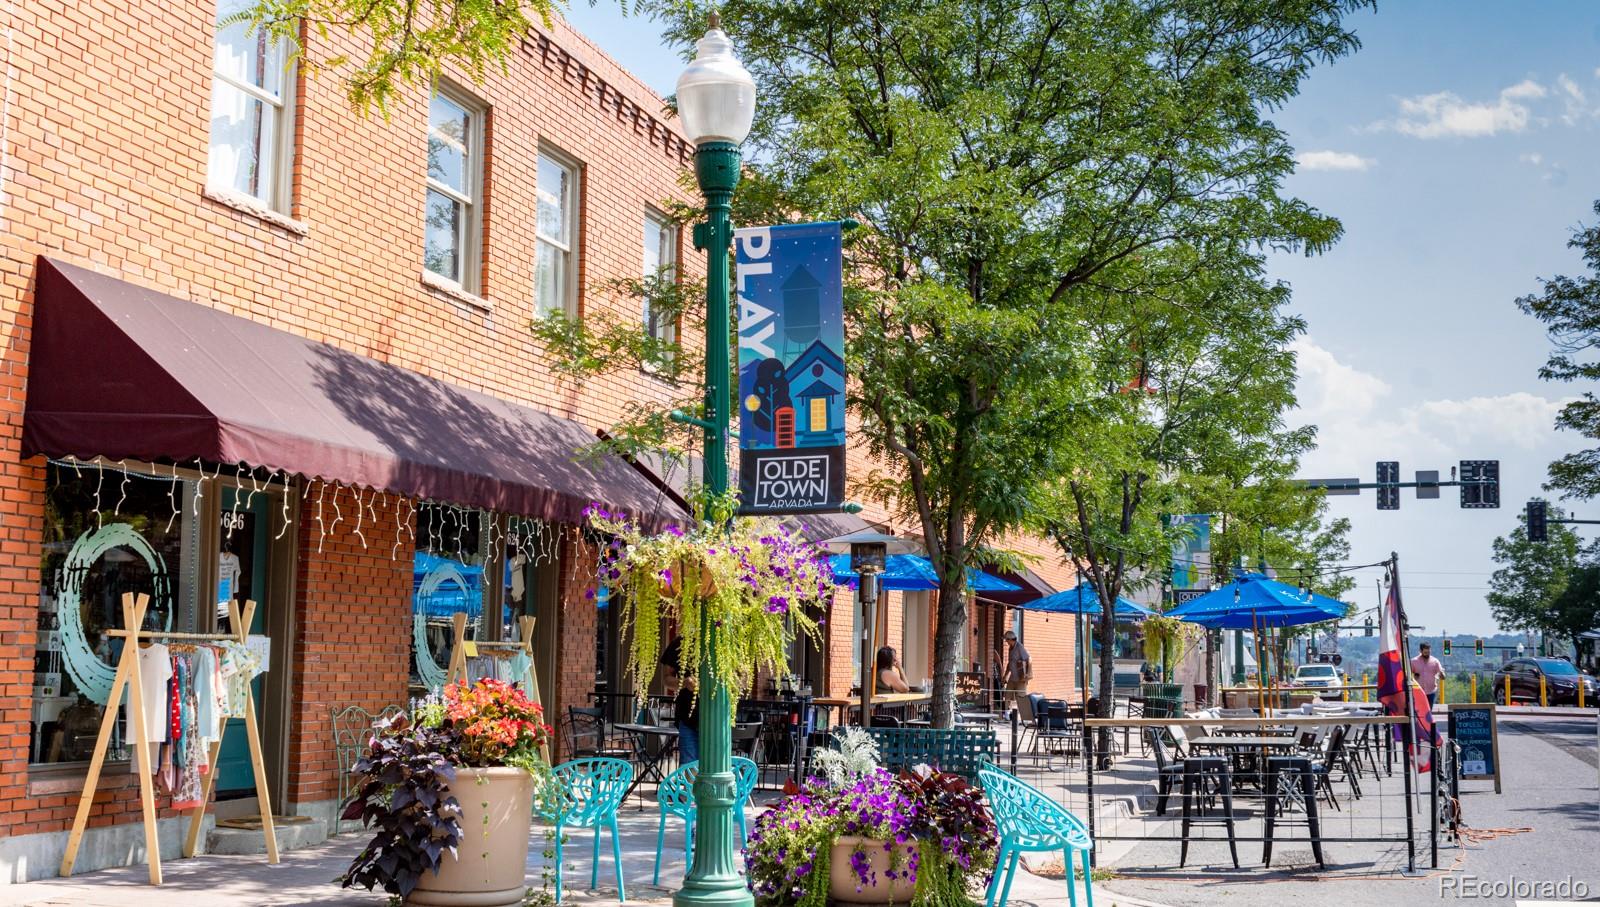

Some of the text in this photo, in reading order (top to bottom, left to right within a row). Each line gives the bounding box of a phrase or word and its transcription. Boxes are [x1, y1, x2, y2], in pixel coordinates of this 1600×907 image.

[734, 227, 776, 359] PLAY
[764, 459, 821, 479] OLDE
[759, 479, 825, 498] TOWN
[769, 498, 813, 508] ARVADA
